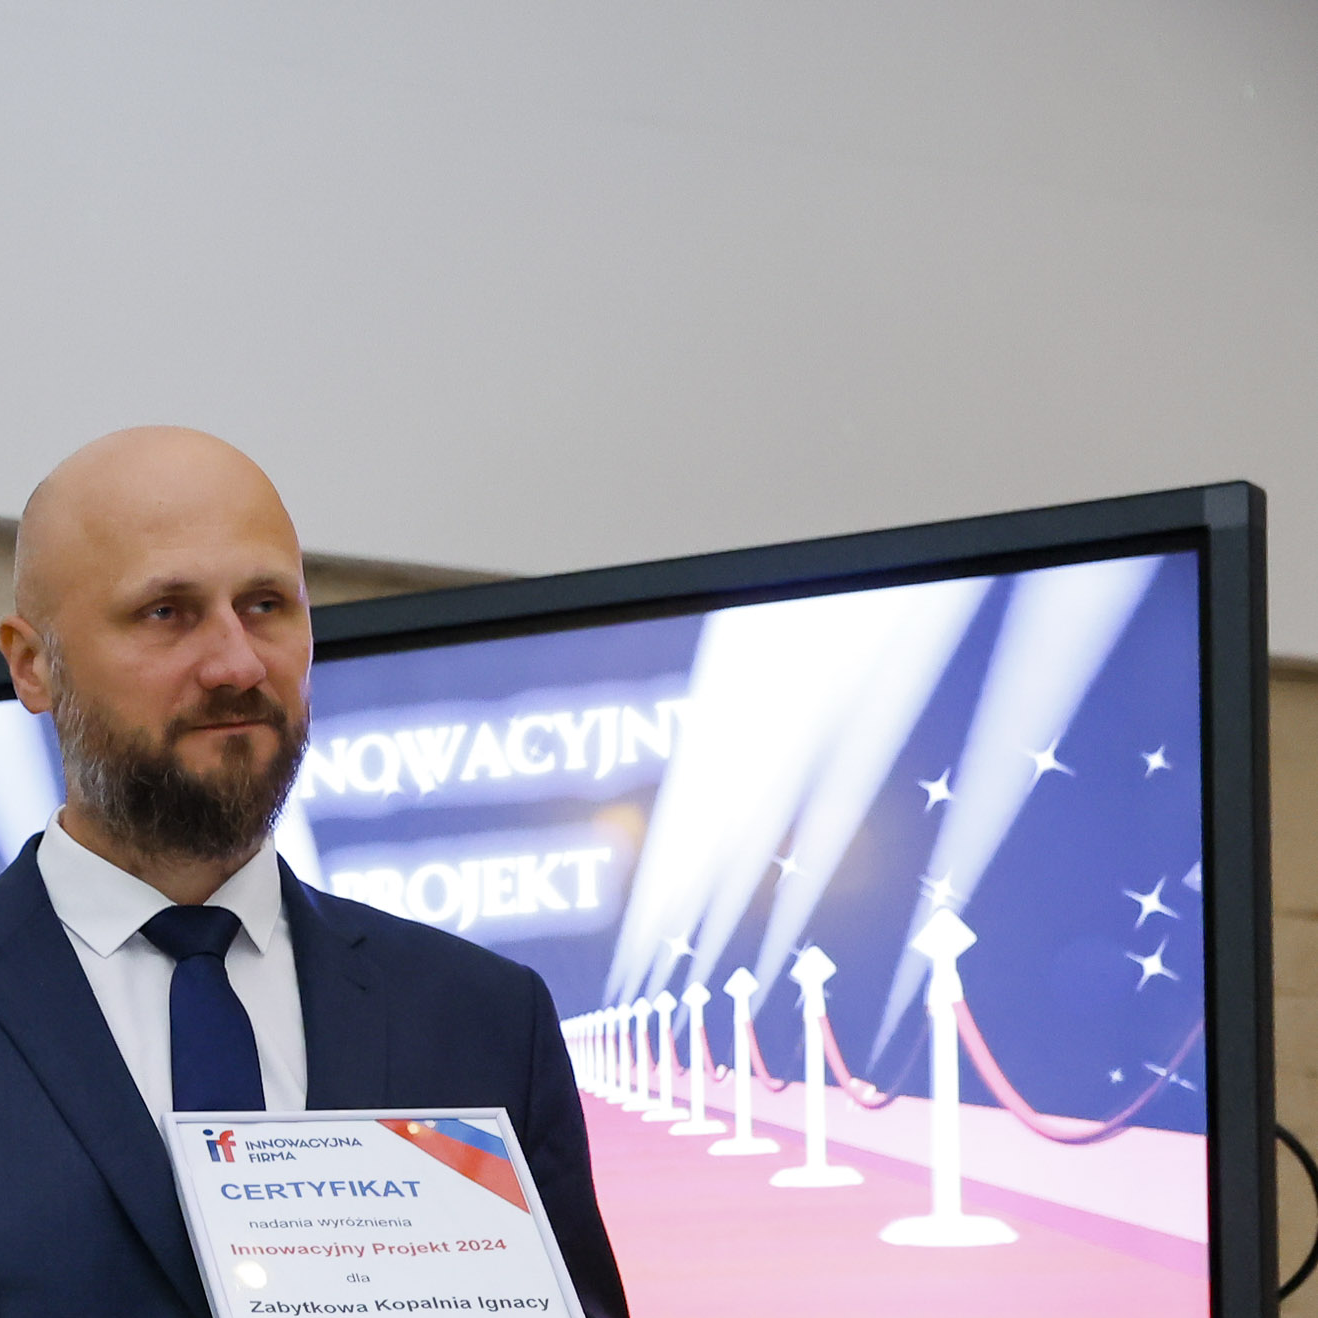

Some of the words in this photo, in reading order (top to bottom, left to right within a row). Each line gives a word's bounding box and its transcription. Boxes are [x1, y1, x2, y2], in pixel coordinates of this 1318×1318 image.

[299, 698, 692, 798] NOWACYJN
[245, 1137, 363, 1151] INNOWACYJNA
[248, 1151, 297, 1163] FIRMA
[220, 1180, 421, 1200] CERTYFIKAT
[249, 1217, 314, 1229] nadania
[317, 1216, 412, 1230] wyróżnienia
[230, 1242, 365, 1258] Innowacyjny
[372, 1241, 451, 1257] Projekt
[456, 1238, 508, 1252] 2024
[346, 1272, 371, 1283] dla
[249, 1300, 369, 1317] Zabytkowa
[375, 1296, 472, 1314] Kopalnia
[478, 1296, 550, 1312] Ignacy
